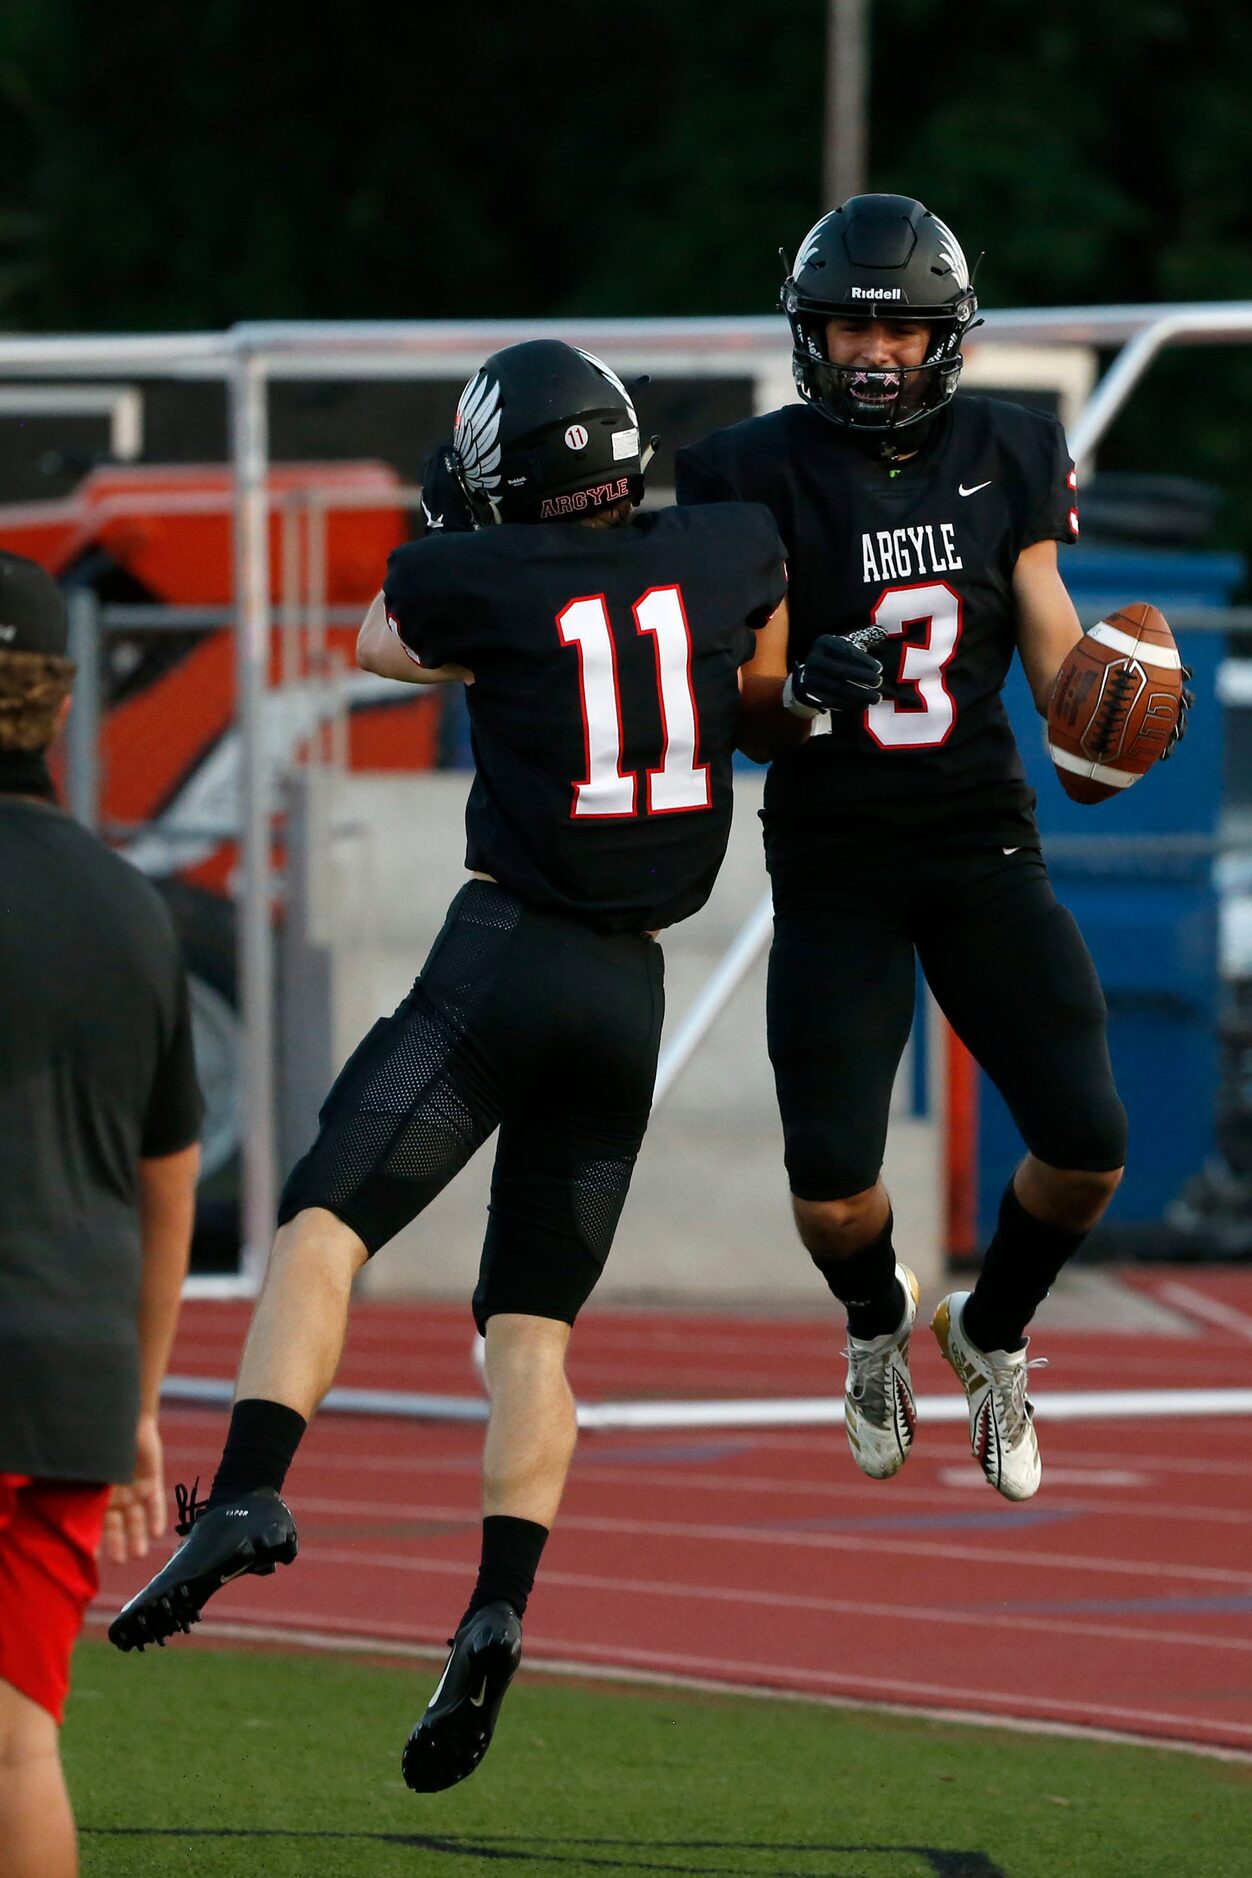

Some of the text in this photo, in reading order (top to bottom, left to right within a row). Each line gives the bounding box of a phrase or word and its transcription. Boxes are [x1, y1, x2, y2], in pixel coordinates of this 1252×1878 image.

[851, 287, 901, 300] Riddell
[567, 427, 585, 448] 11
[540, 477, 629, 518] ARGYLE
[861, 523, 963, 583] ARGYLE
[864, 580, 964, 749] 3
[555, 583, 713, 819] 11
